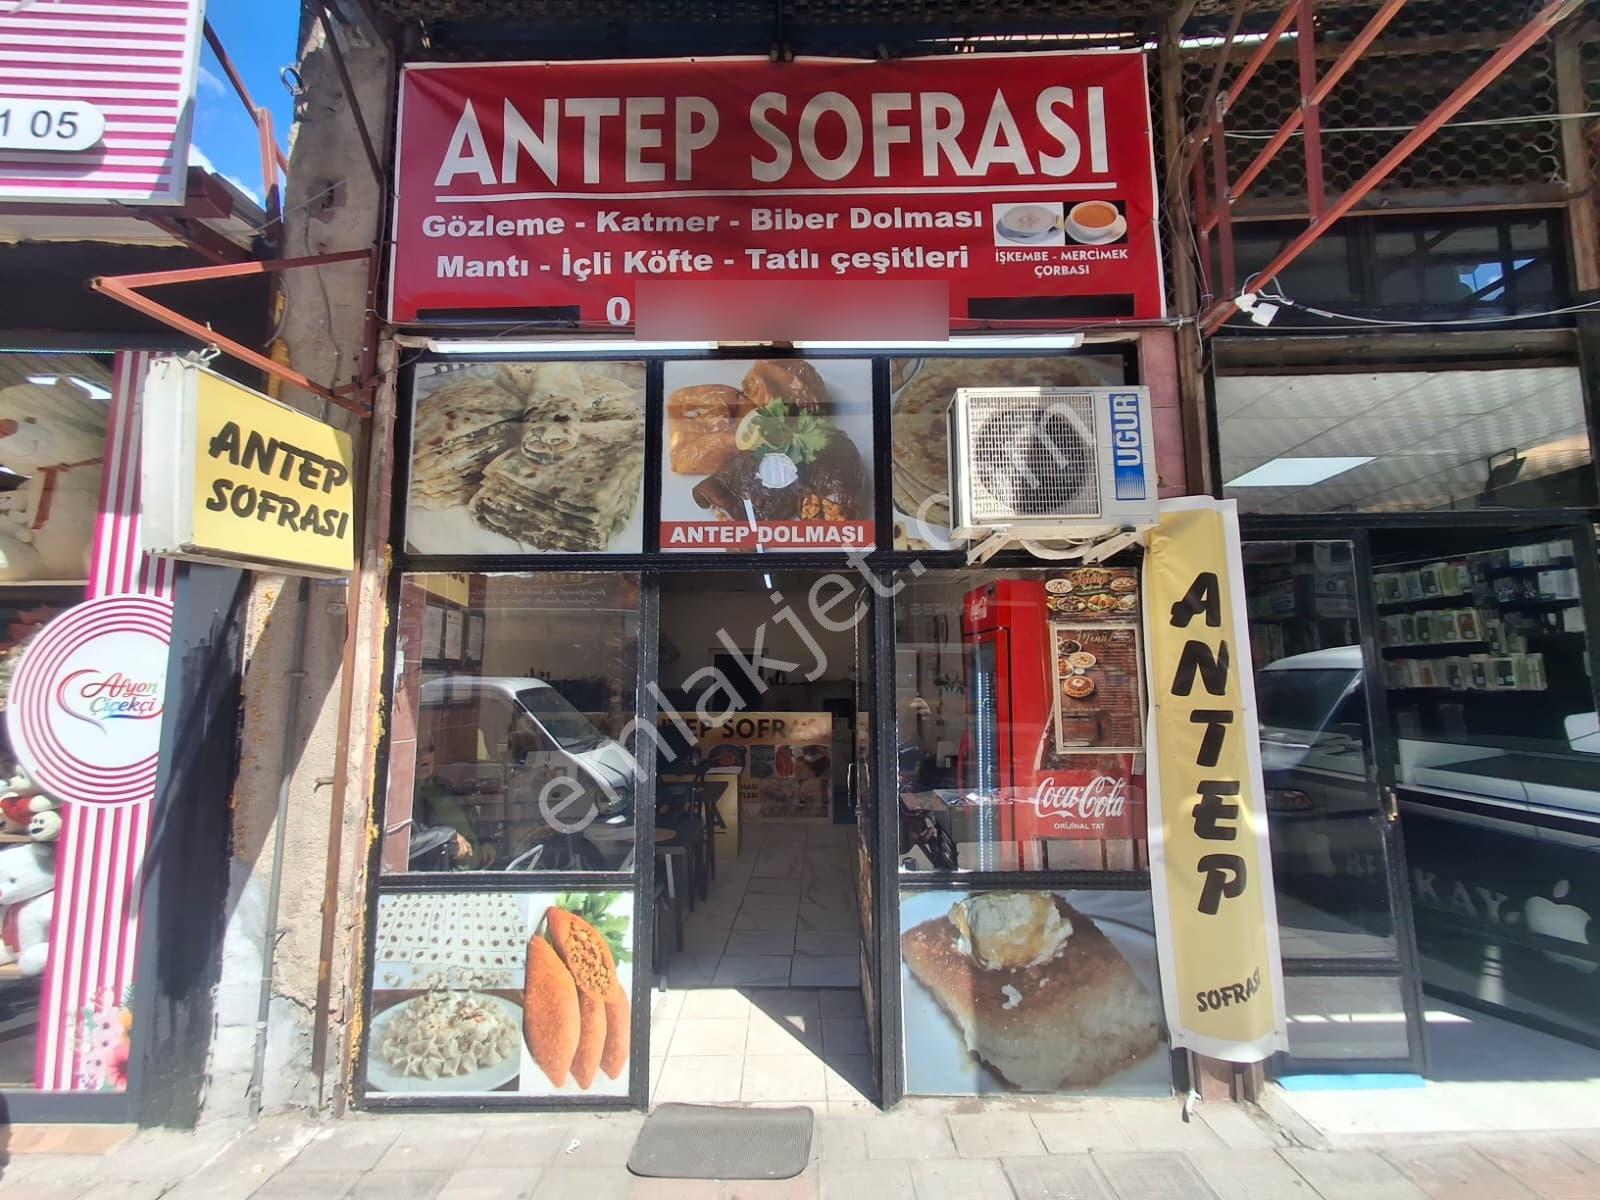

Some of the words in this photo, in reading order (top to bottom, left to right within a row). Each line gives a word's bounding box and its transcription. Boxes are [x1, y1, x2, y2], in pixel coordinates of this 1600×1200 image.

[31, 110, 80, 139] 05
[434, 96, 719, 186] ANTEP
[750, 86, 1108, 182] SOFRASI
[422, 214, 565, 238] Gözleme
[597, 210, 720, 233] Katmer
[751, 207, 838, 231] Biber
[850, 206, 983, 229] Dolması
[436, 254, 529, 278] Mantı
[562, 247, 612, 282] İçli
[624, 248, 714, 274] Köfte
[745, 246, 819, 271] Tatlı
[831, 244, 969, 275] çeşitleri
[995, 248, 1049, 265] İŞKEMBE
[1060, 247, 1128, 262] MERCİMEK
[1034, 265, 1090, 279] ÇORBASI
[208, 421, 349, 494] ANTEP
[206, 478, 349, 539] SOFRASI
[669, 526, 750, 543] ANTEP
[757, 525, 864, 542] DOLMASI
[80, 672, 158, 698] Afyon
[90, 696, 157, 716] Çiçekçi
[1169, 572, 1247, 915] ANTEP
[1091, 822, 1105, 830] TAT
[1196, 965, 1261, 1012] SOFRASI
